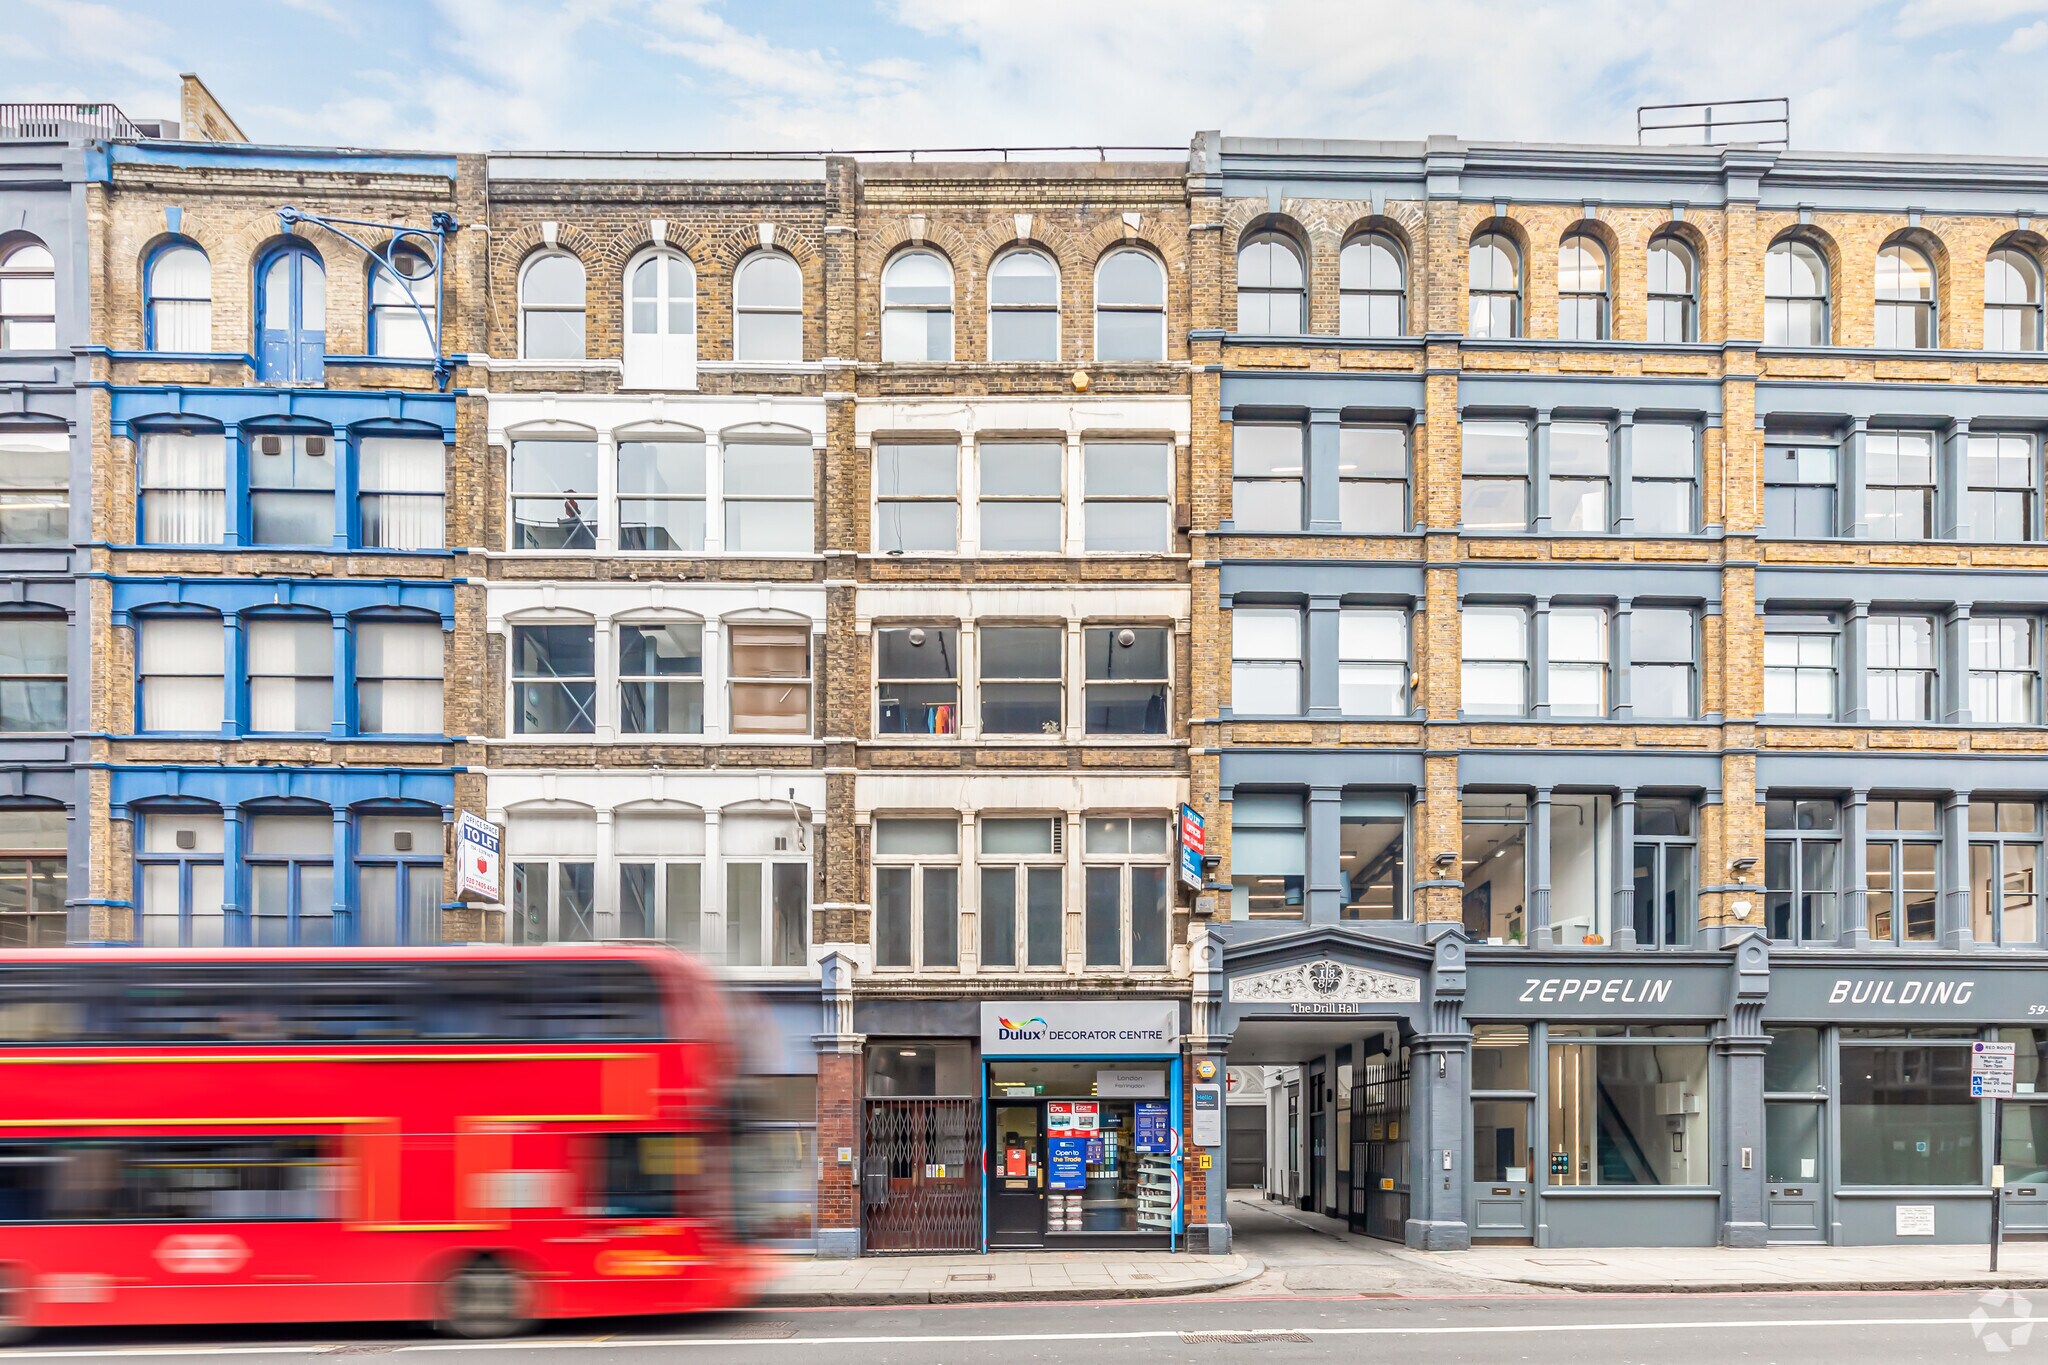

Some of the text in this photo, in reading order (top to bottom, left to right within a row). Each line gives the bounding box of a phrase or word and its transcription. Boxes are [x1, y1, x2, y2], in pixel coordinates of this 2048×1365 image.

[466, 815, 498, 836] OFFICE SPACE
[465, 826, 480, 842] TO
[482, 833, 498, 852] LET
[466, 876, 474, 885] 020
[1519, 979, 1672, 1002] ZEPPELIN
[1828, 980, 1974, 1004] BUILDING
[1291, 1002, 1359, 1013] The Drill Hall
[998, 1028, 1162, 1040] Dulux DECORATOR CENTRE
[1202, 1157, 1210, 1166] H
